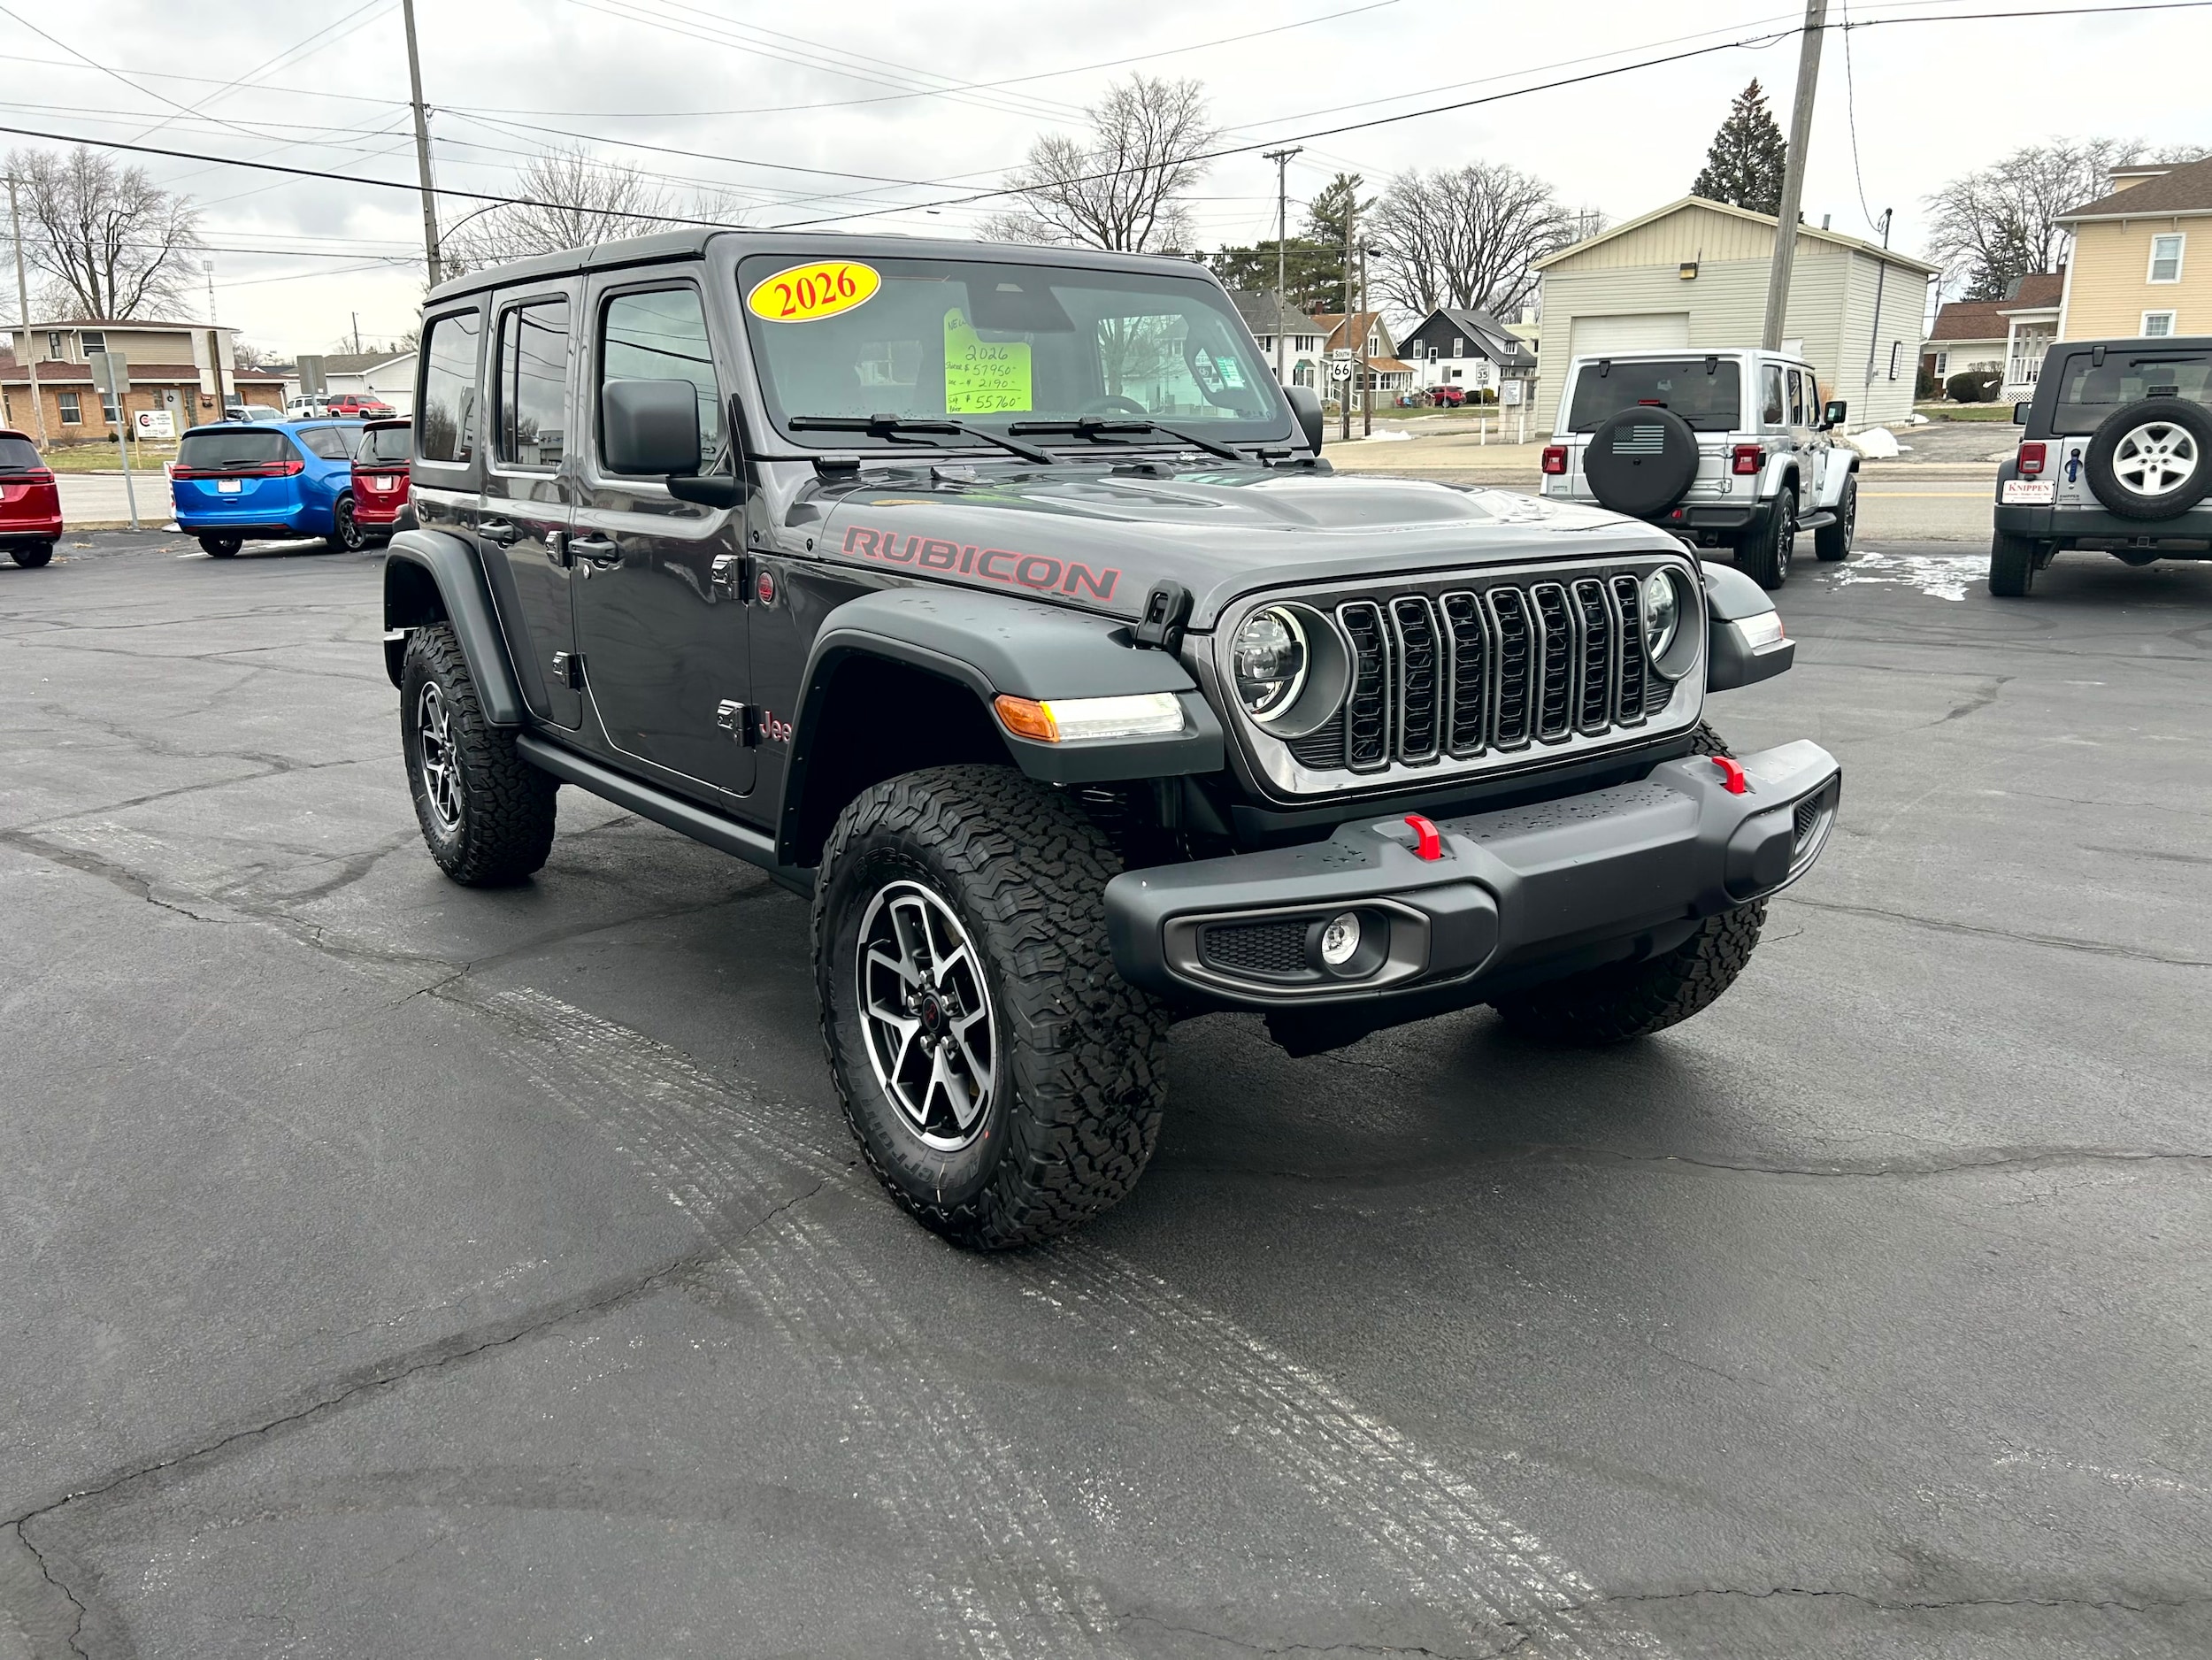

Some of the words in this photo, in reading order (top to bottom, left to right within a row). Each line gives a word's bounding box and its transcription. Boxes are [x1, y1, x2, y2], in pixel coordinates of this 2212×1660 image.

[774, 265, 856, 317] 2026
[965, 344, 1009, 361] 2026
[1334, 364, 1349, 375] 66
[842, 526, 1122, 602] RUBICON
[759, 711, 793, 744] Jee
